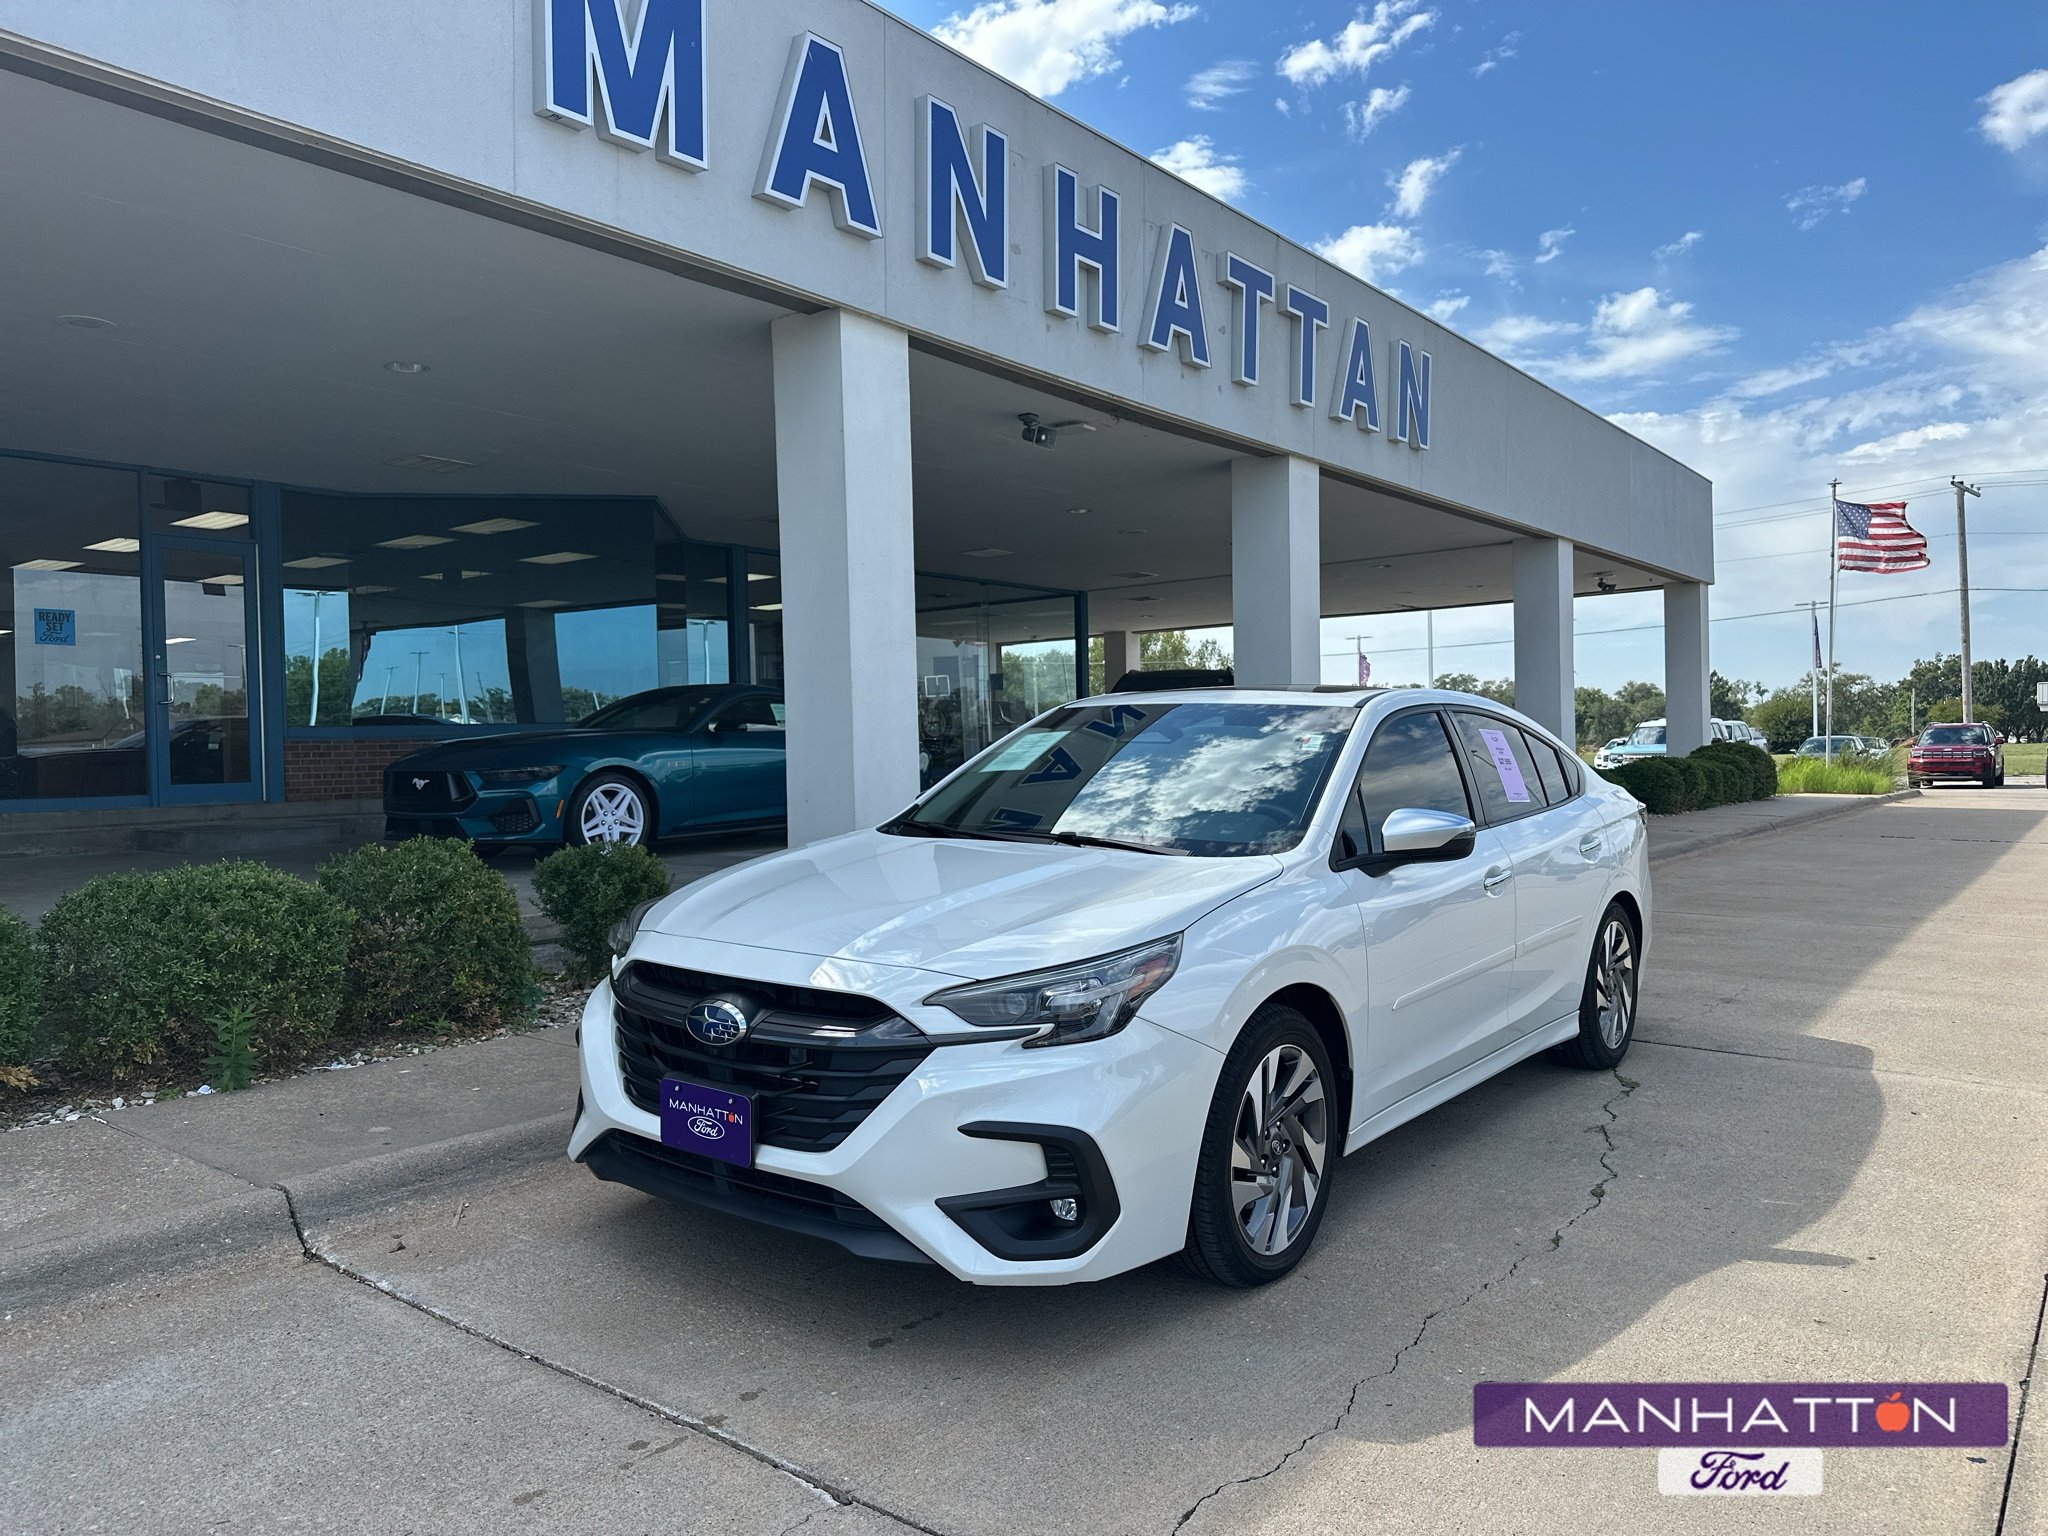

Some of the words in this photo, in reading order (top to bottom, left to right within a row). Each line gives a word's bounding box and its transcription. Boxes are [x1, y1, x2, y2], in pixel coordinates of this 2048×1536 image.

[536, 0, 1432, 450] MANHATTAN
[38, 611, 71, 623] READY
[46, 621, 64, 632] SET
[40, 631, 71, 643] Ford
[694, 1118, 719, 1137] Ford
